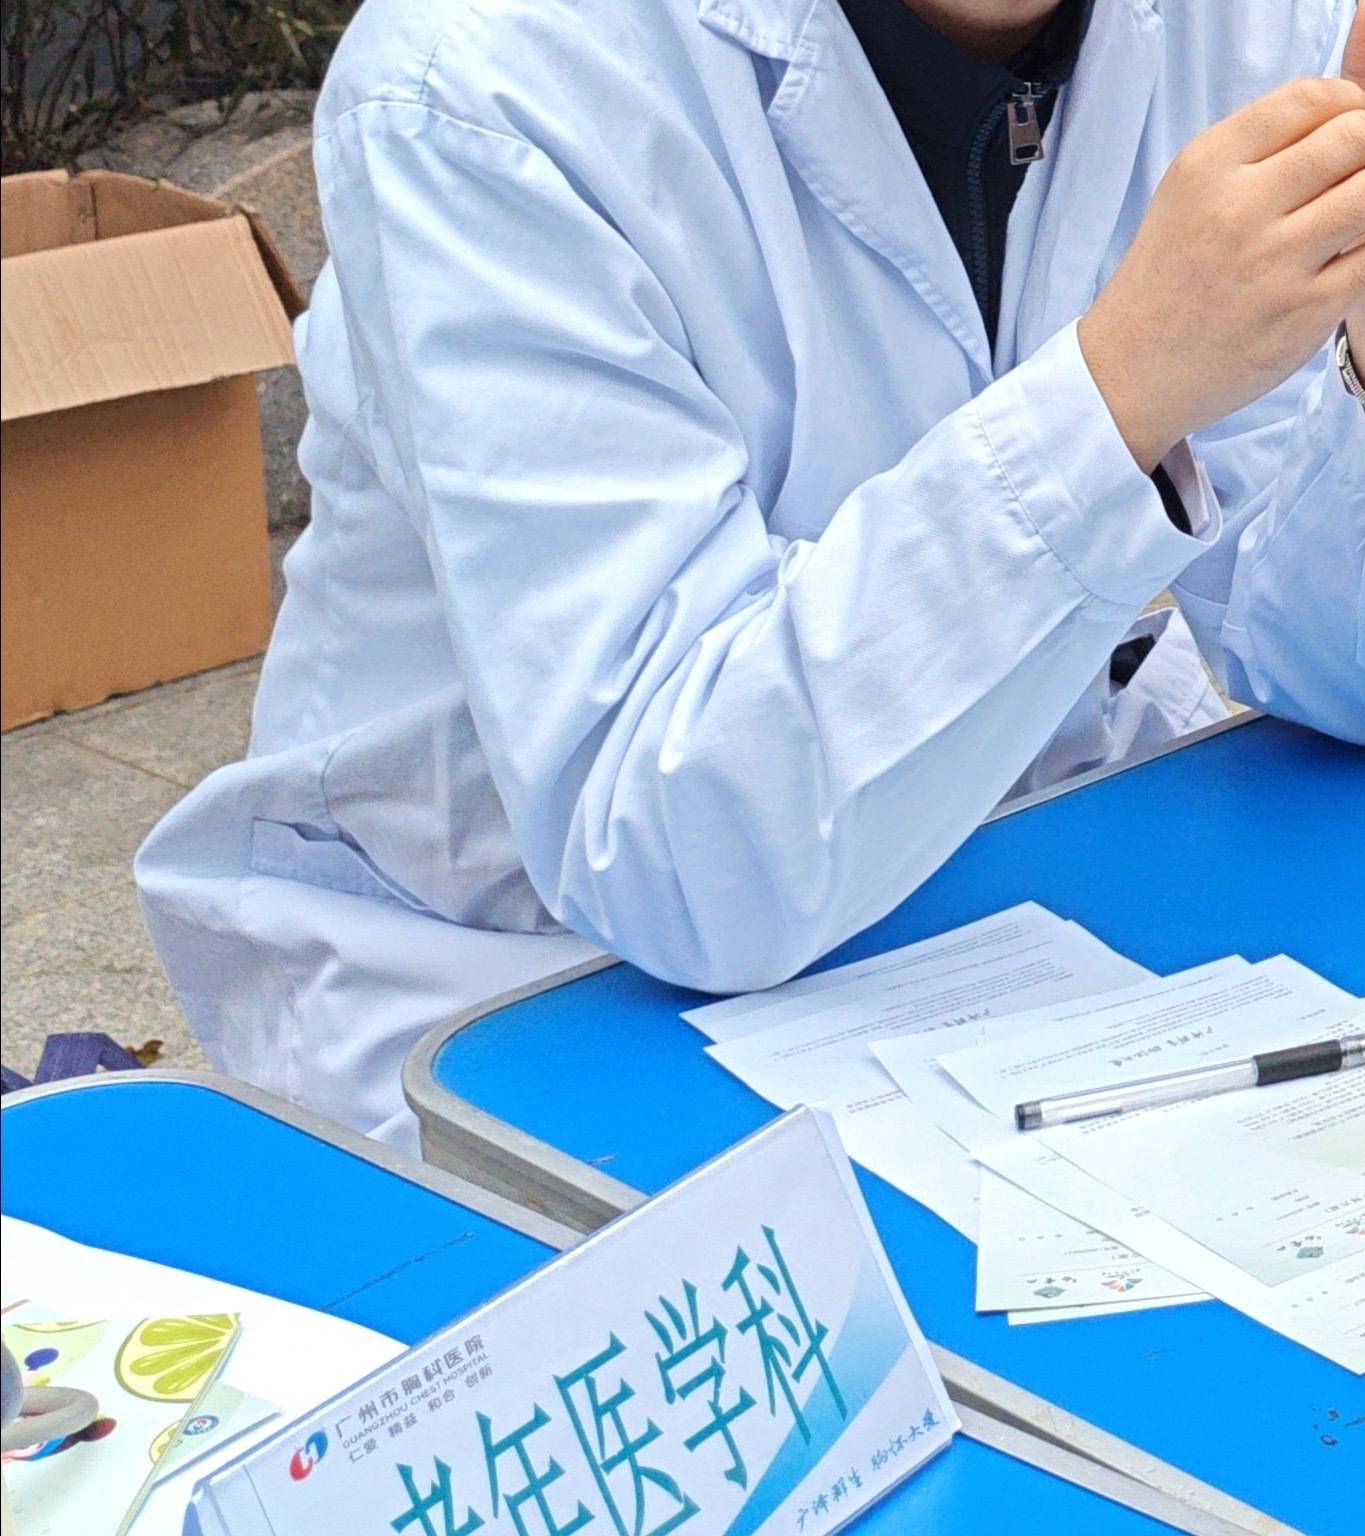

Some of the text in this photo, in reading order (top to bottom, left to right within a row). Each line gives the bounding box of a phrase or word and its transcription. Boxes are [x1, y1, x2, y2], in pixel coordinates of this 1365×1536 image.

[334, 1334, 485, 1439] 广州市胸科医院
[343, 1353, 489, 1449] GUANGZHOU CHEST HOSPITAL
[349, 1365, 494, 1463] 仁爱 精益 和合 创新
